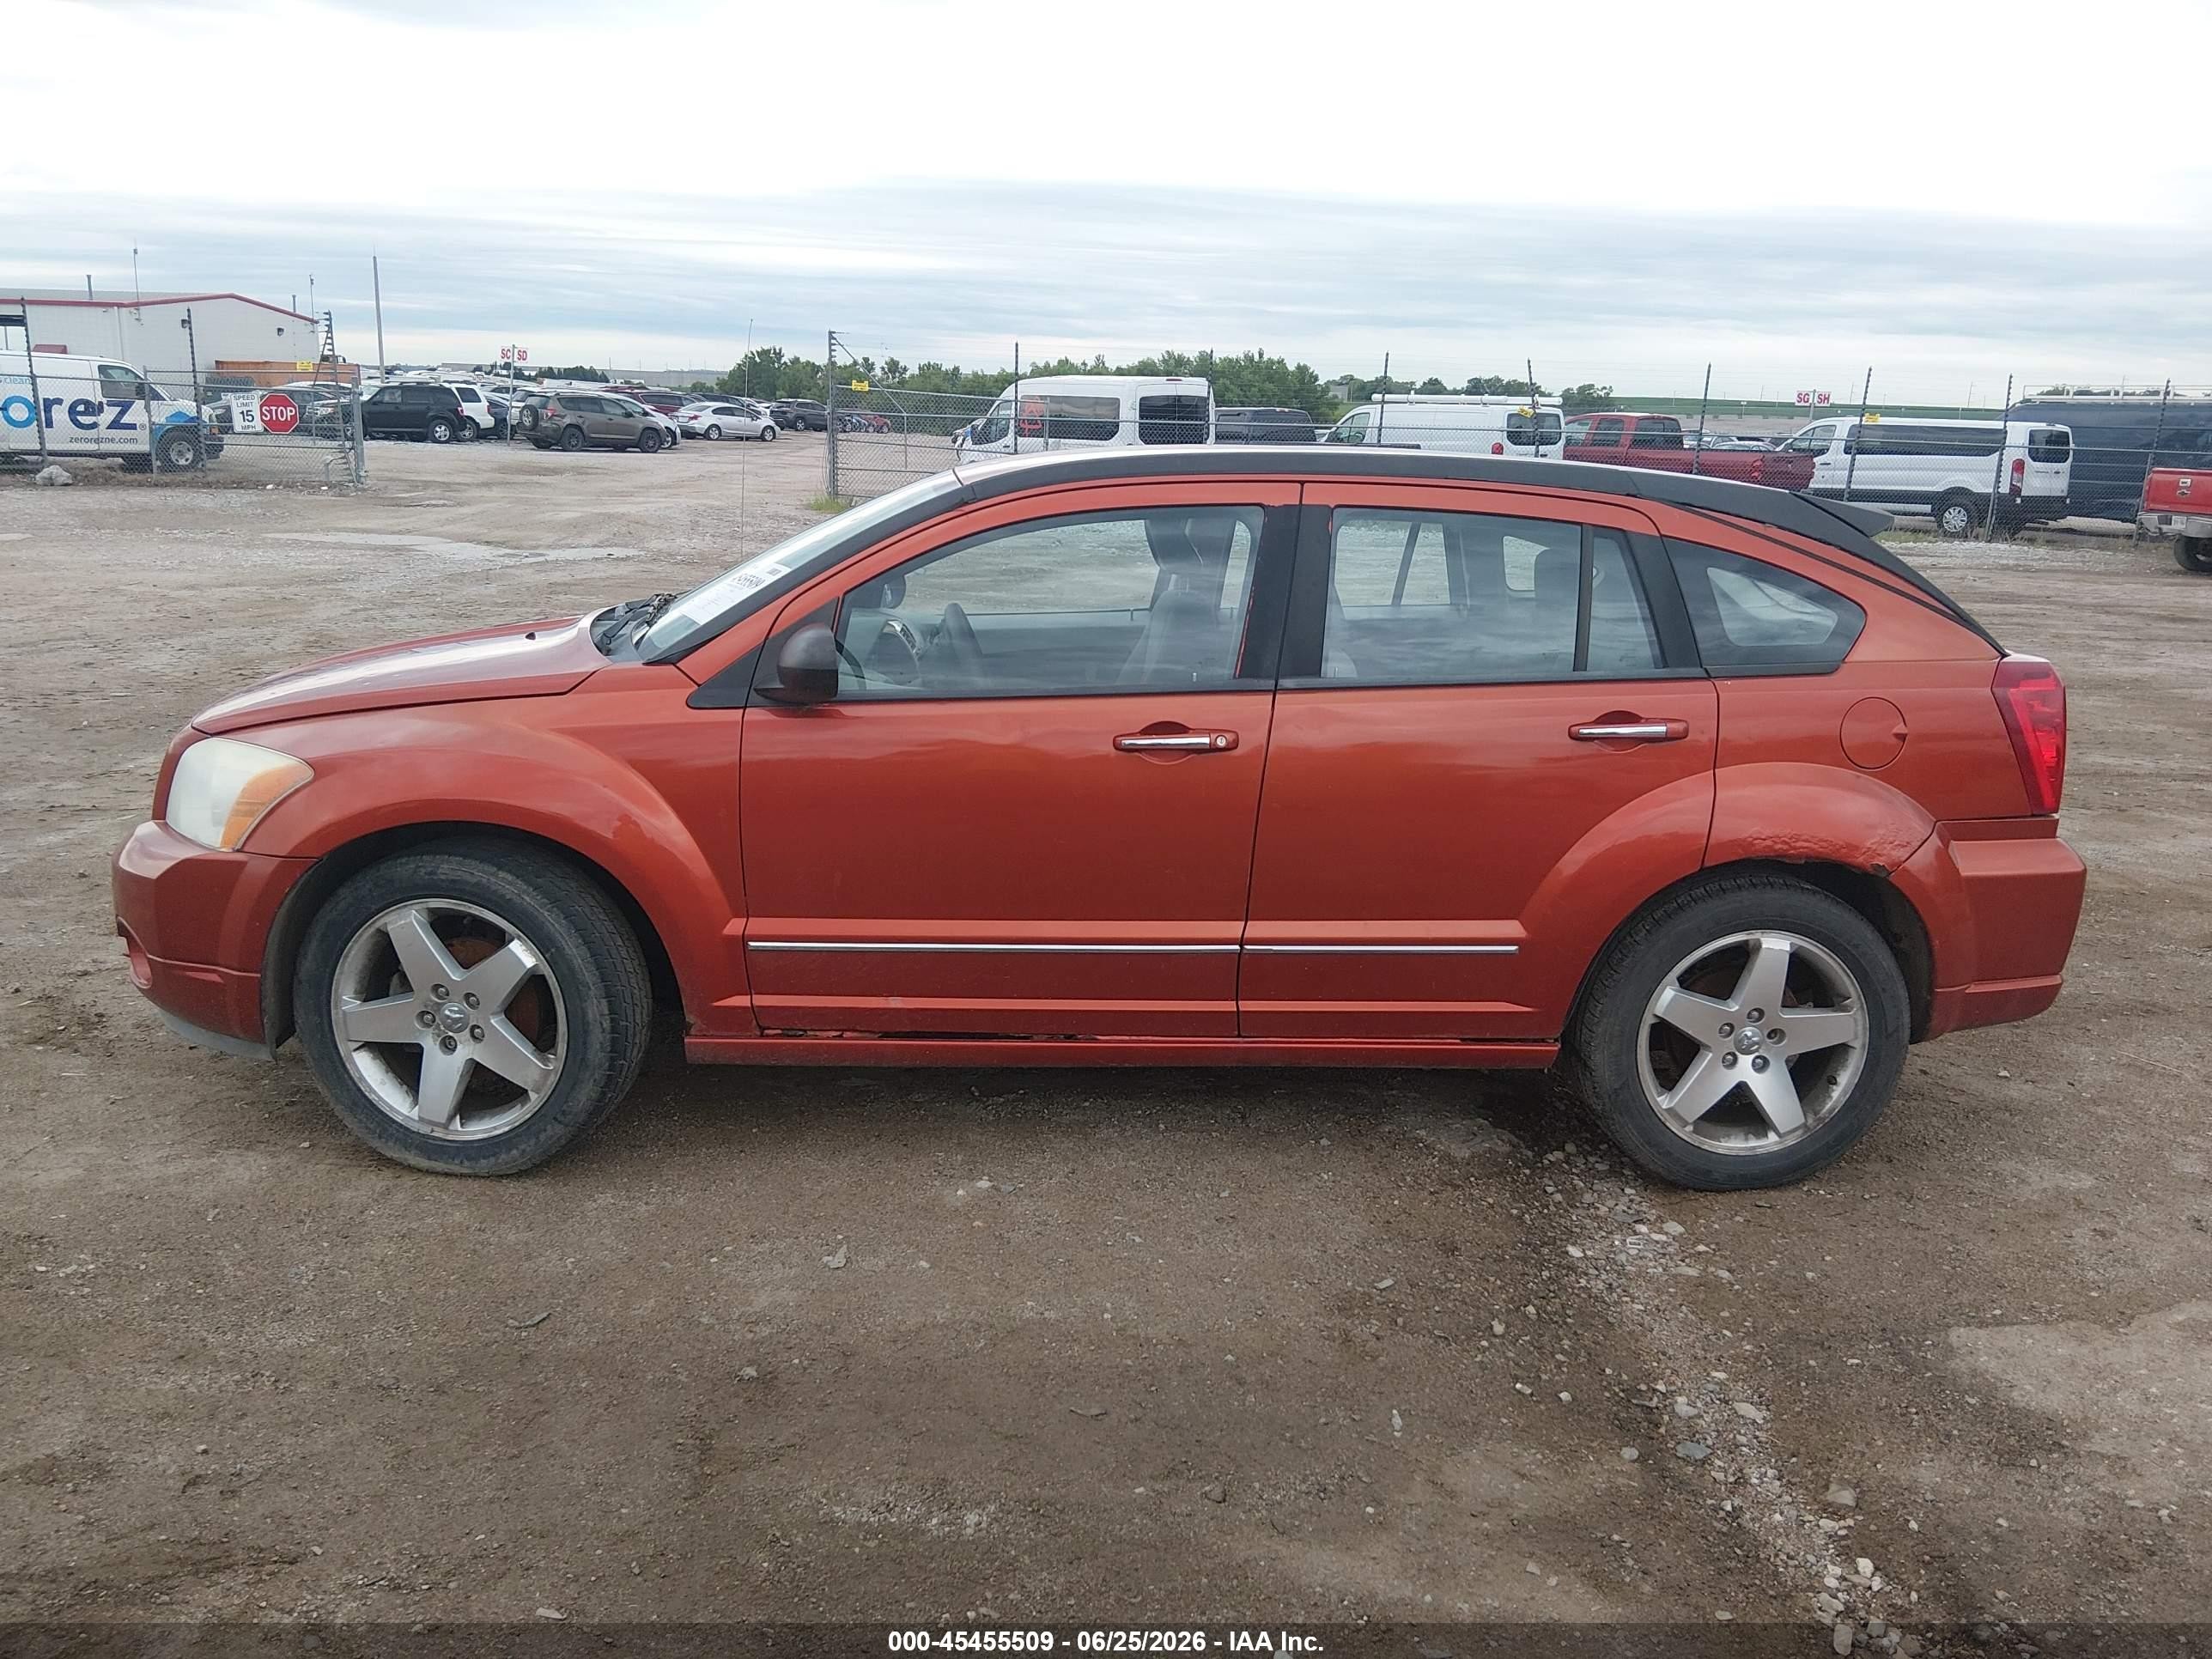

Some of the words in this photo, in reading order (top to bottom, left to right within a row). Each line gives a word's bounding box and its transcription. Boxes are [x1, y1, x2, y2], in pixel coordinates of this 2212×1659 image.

[501, 348, 511, 359] SC
[517, 349, 527, 361] SD
[1796, 392, 1810, 403] SG
[1816, 393, 1830, 404] SH
[0, 395, 137, 431] orez
[240, 410, 255, 422] 15
[262, 406, 295, 422] STOP
[69, 436, 138, 445] zerorezne.com
